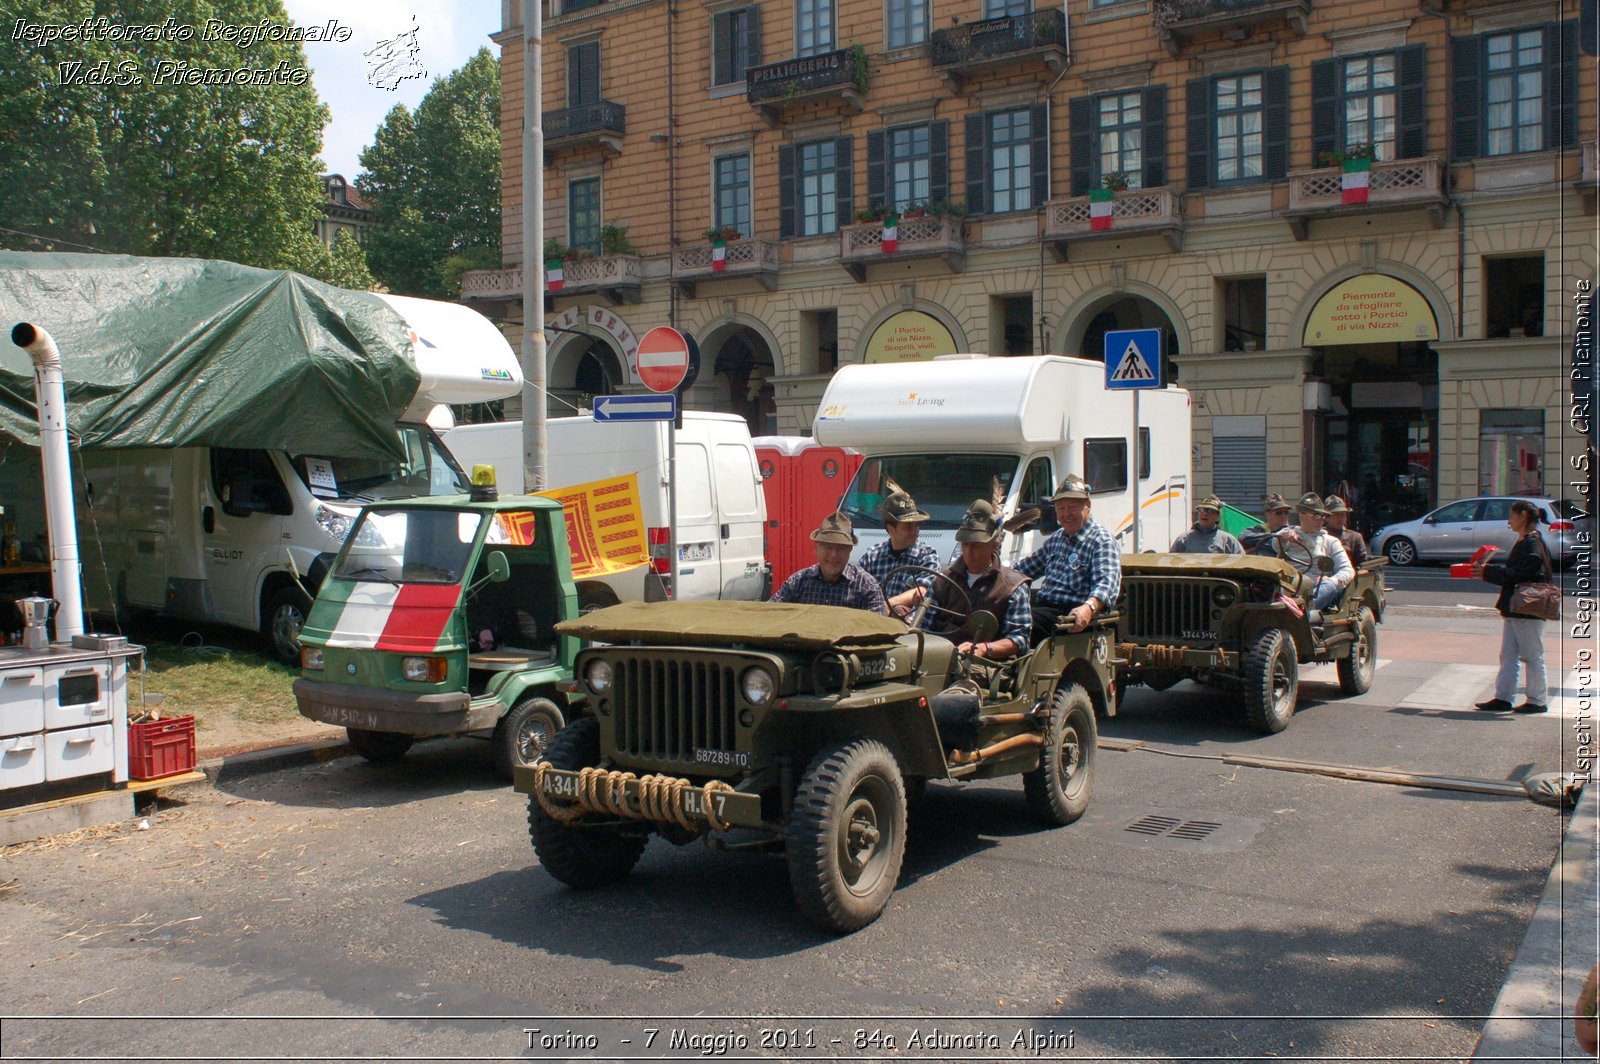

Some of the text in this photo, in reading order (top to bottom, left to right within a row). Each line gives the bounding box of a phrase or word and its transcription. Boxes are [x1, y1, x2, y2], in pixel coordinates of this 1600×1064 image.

[1342, 291, 1396, 301] Piemonte
[1336, 301, 1402, 312] da sfogliare
[1331, 311, 1408, 322] sotto i Portici
[899, 326, 926, 334] Portici
[1336, 323, 1347, 332] di
[1368, 321, 1402, 330] Nizza.
[887, 335, 895, 343] di
[896, 335, 908, 343] via
[884, 342, 937, 352] Scoprili, vivili,
[896, 397, 945, 407] Sun Living
